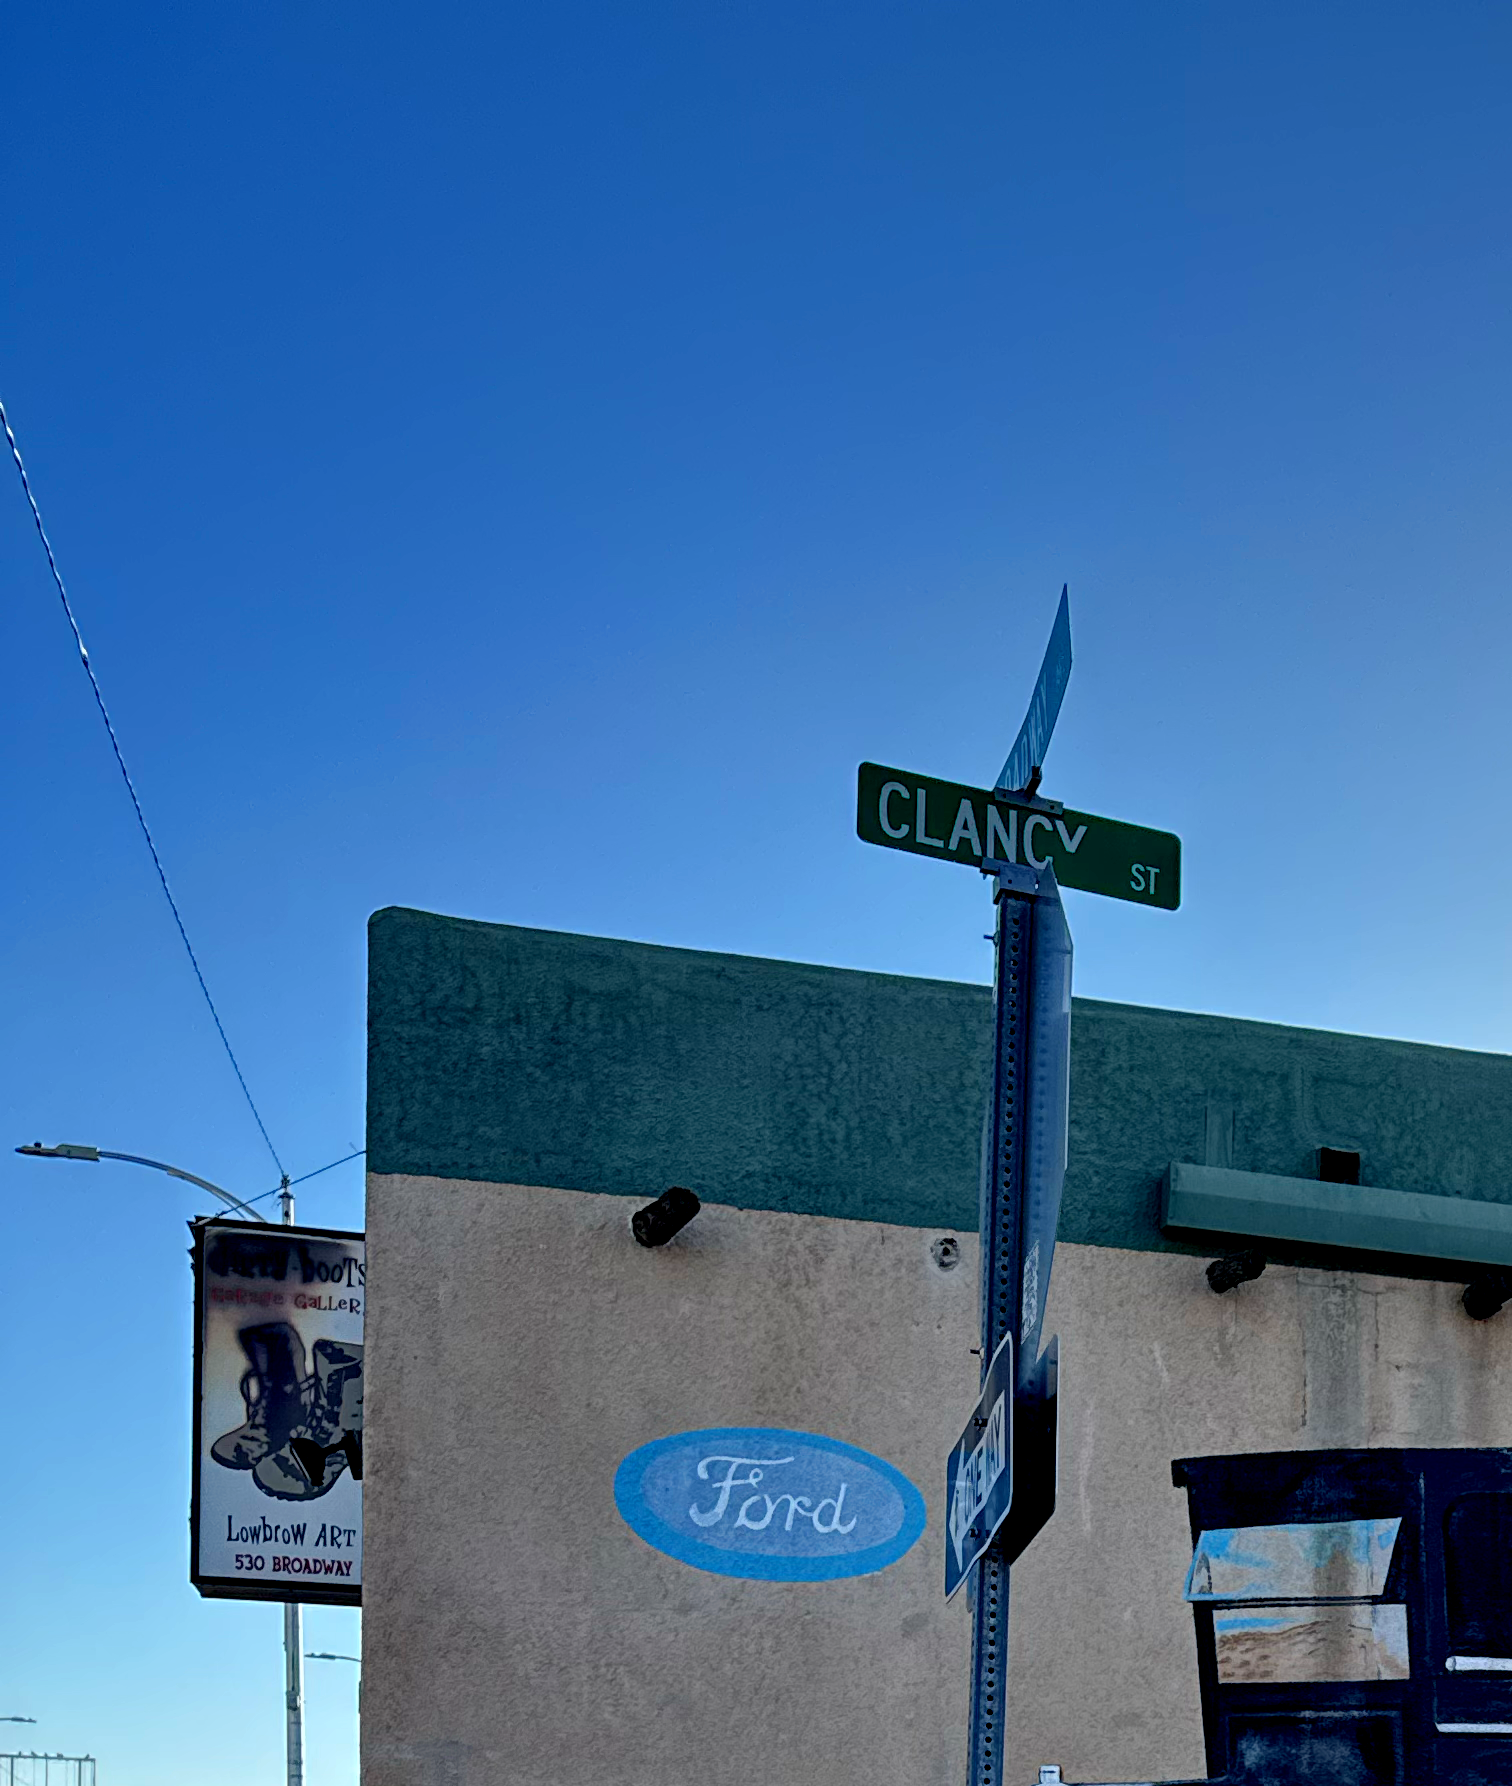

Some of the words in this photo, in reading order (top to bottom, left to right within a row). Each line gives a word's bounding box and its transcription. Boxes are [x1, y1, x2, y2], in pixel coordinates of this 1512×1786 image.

[878, 781, 1088, 870] CLANCY
[1129, 863, 1160, 895] ST
[688, 1455, 858, 1535] Ford
[314, 1523, 356, 1549] ART
[235, 1554, 265, 1571] 530
[272, 1556, 353, 1576] BROADWAY
